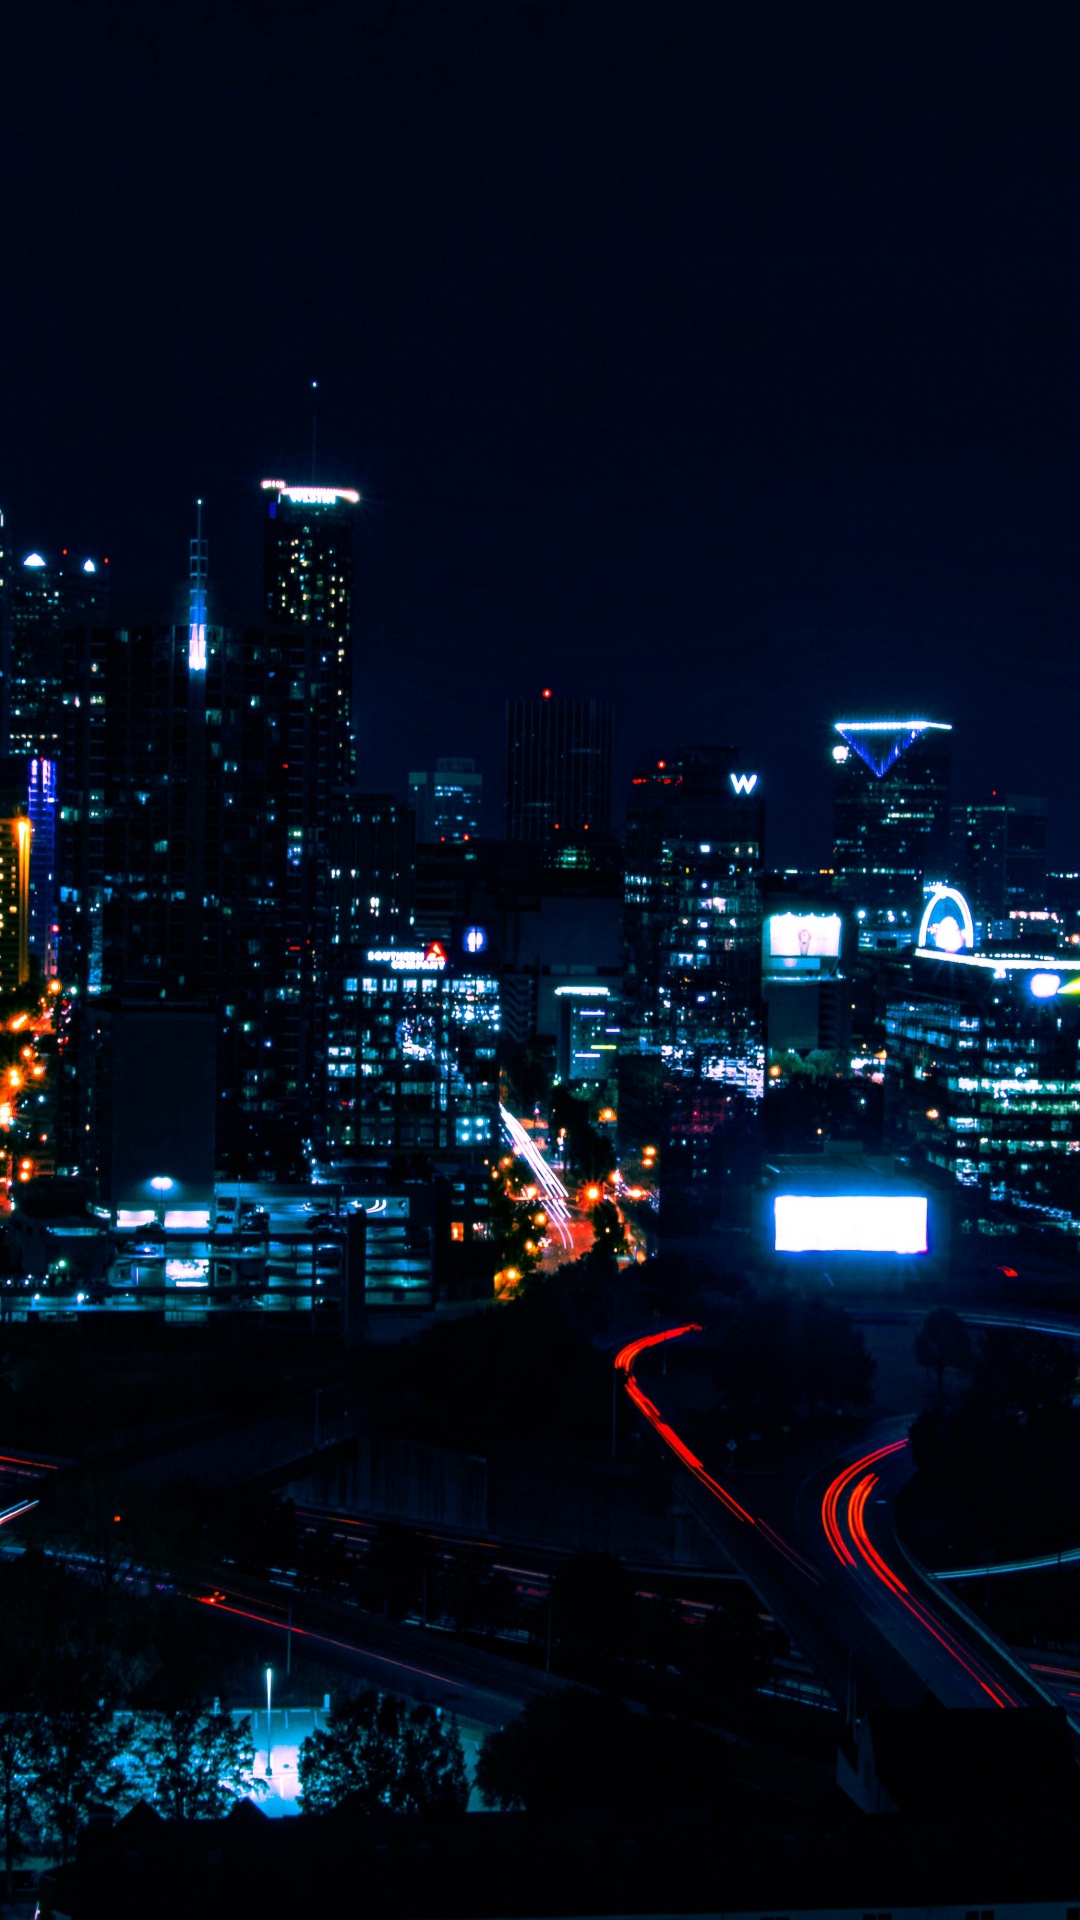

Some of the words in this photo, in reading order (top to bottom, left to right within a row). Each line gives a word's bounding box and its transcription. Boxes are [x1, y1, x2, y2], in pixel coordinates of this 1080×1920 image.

[730, 773, 758, 795] W
[367, 951, 425, 961] SOUTHERN
[390, 960, 446, 970] COMPANY
